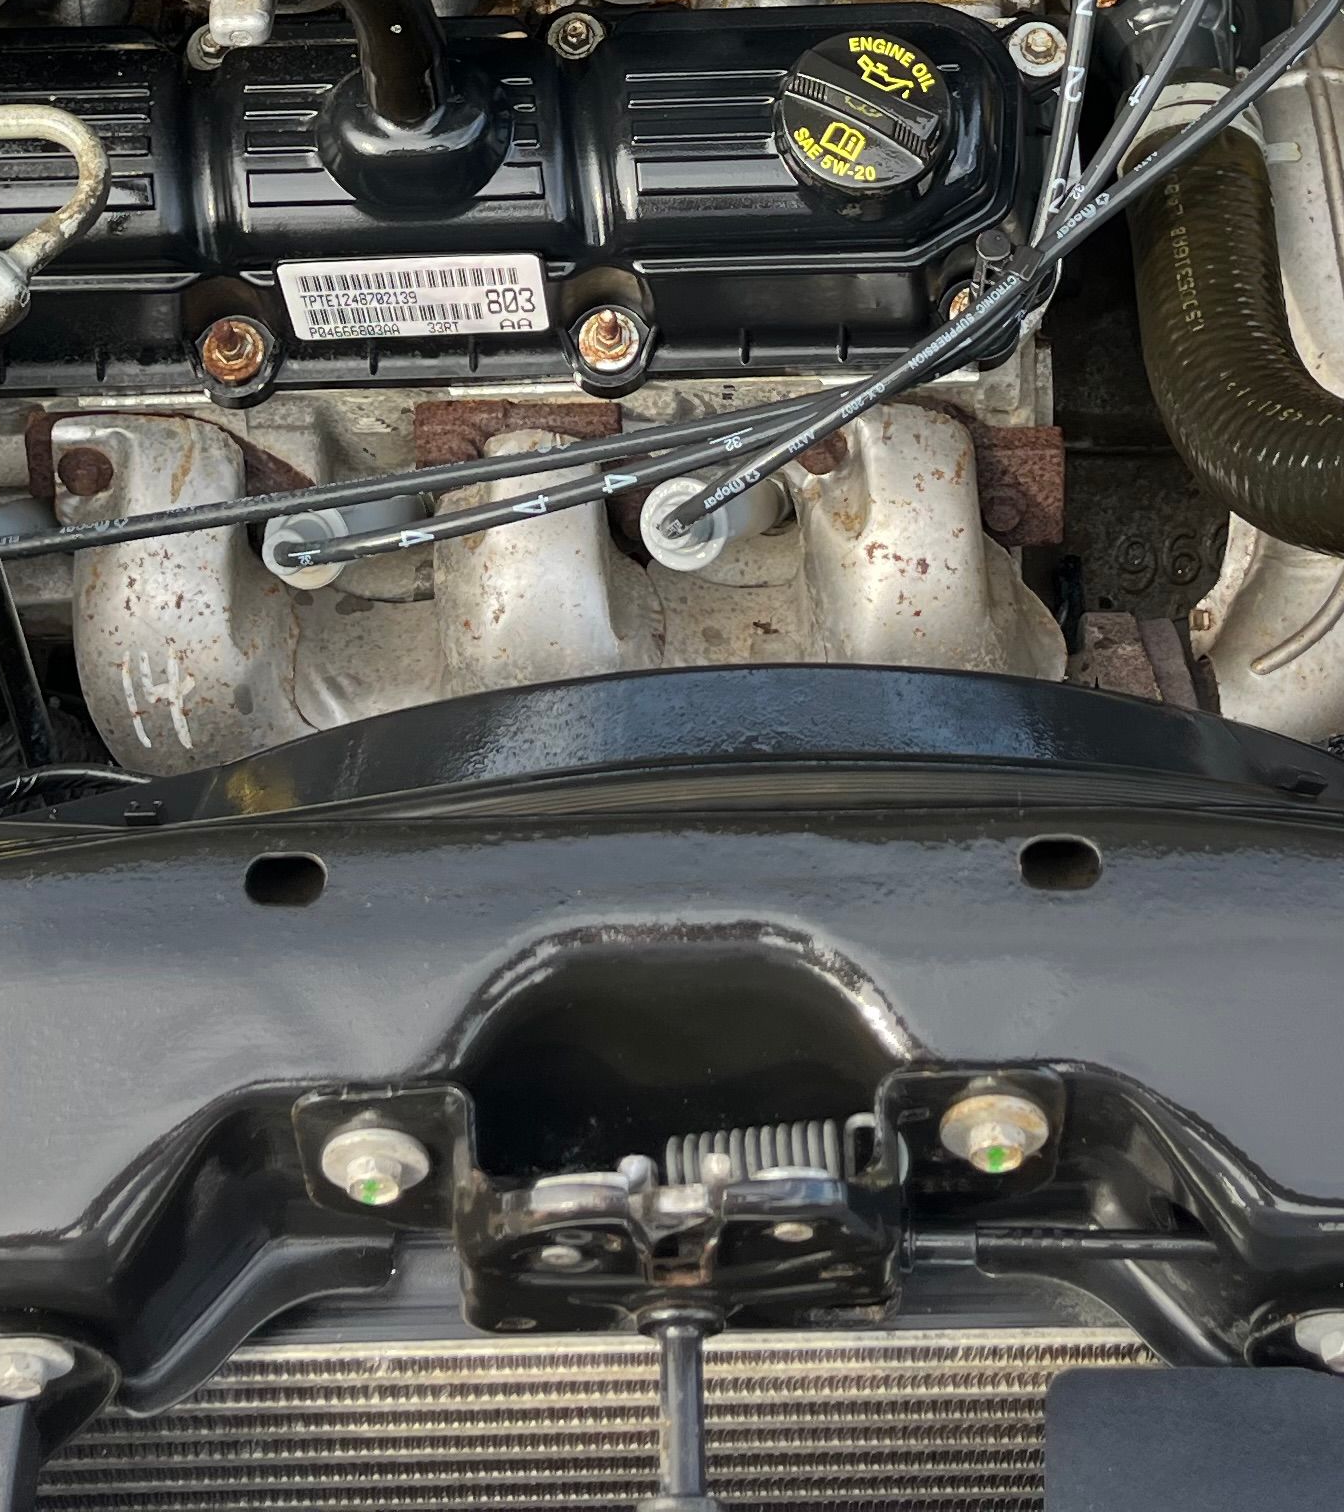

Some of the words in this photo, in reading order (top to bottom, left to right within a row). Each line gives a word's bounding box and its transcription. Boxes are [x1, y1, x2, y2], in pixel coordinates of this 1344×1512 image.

[849, 37, 916, 67] ENGINE
[912, 62, 936, 93] OIL
[1065, 66, 1085, 103] 2
[1128, 74, 1150, 106] 4
[793, 127, 823, 160] SAE
[821, 156, 875, 181] 5W-20
[1056, 206, 1097, 240] Mopar
[485, 288, 536, 314] 803
[428, 322, 459, 334] 33RT
[499, 318, 532, 330] AA
[908, 311, 976, 370] SUPPRESSION
[725, 436, 743, 452] 32
[602, 474, 638, 494] 4
[704, 478, 745, 510] Mopar
[512, 494, 549, 515] 4
[397, 529, 435, 549] 4
[122, 650, 195, 749] 14
